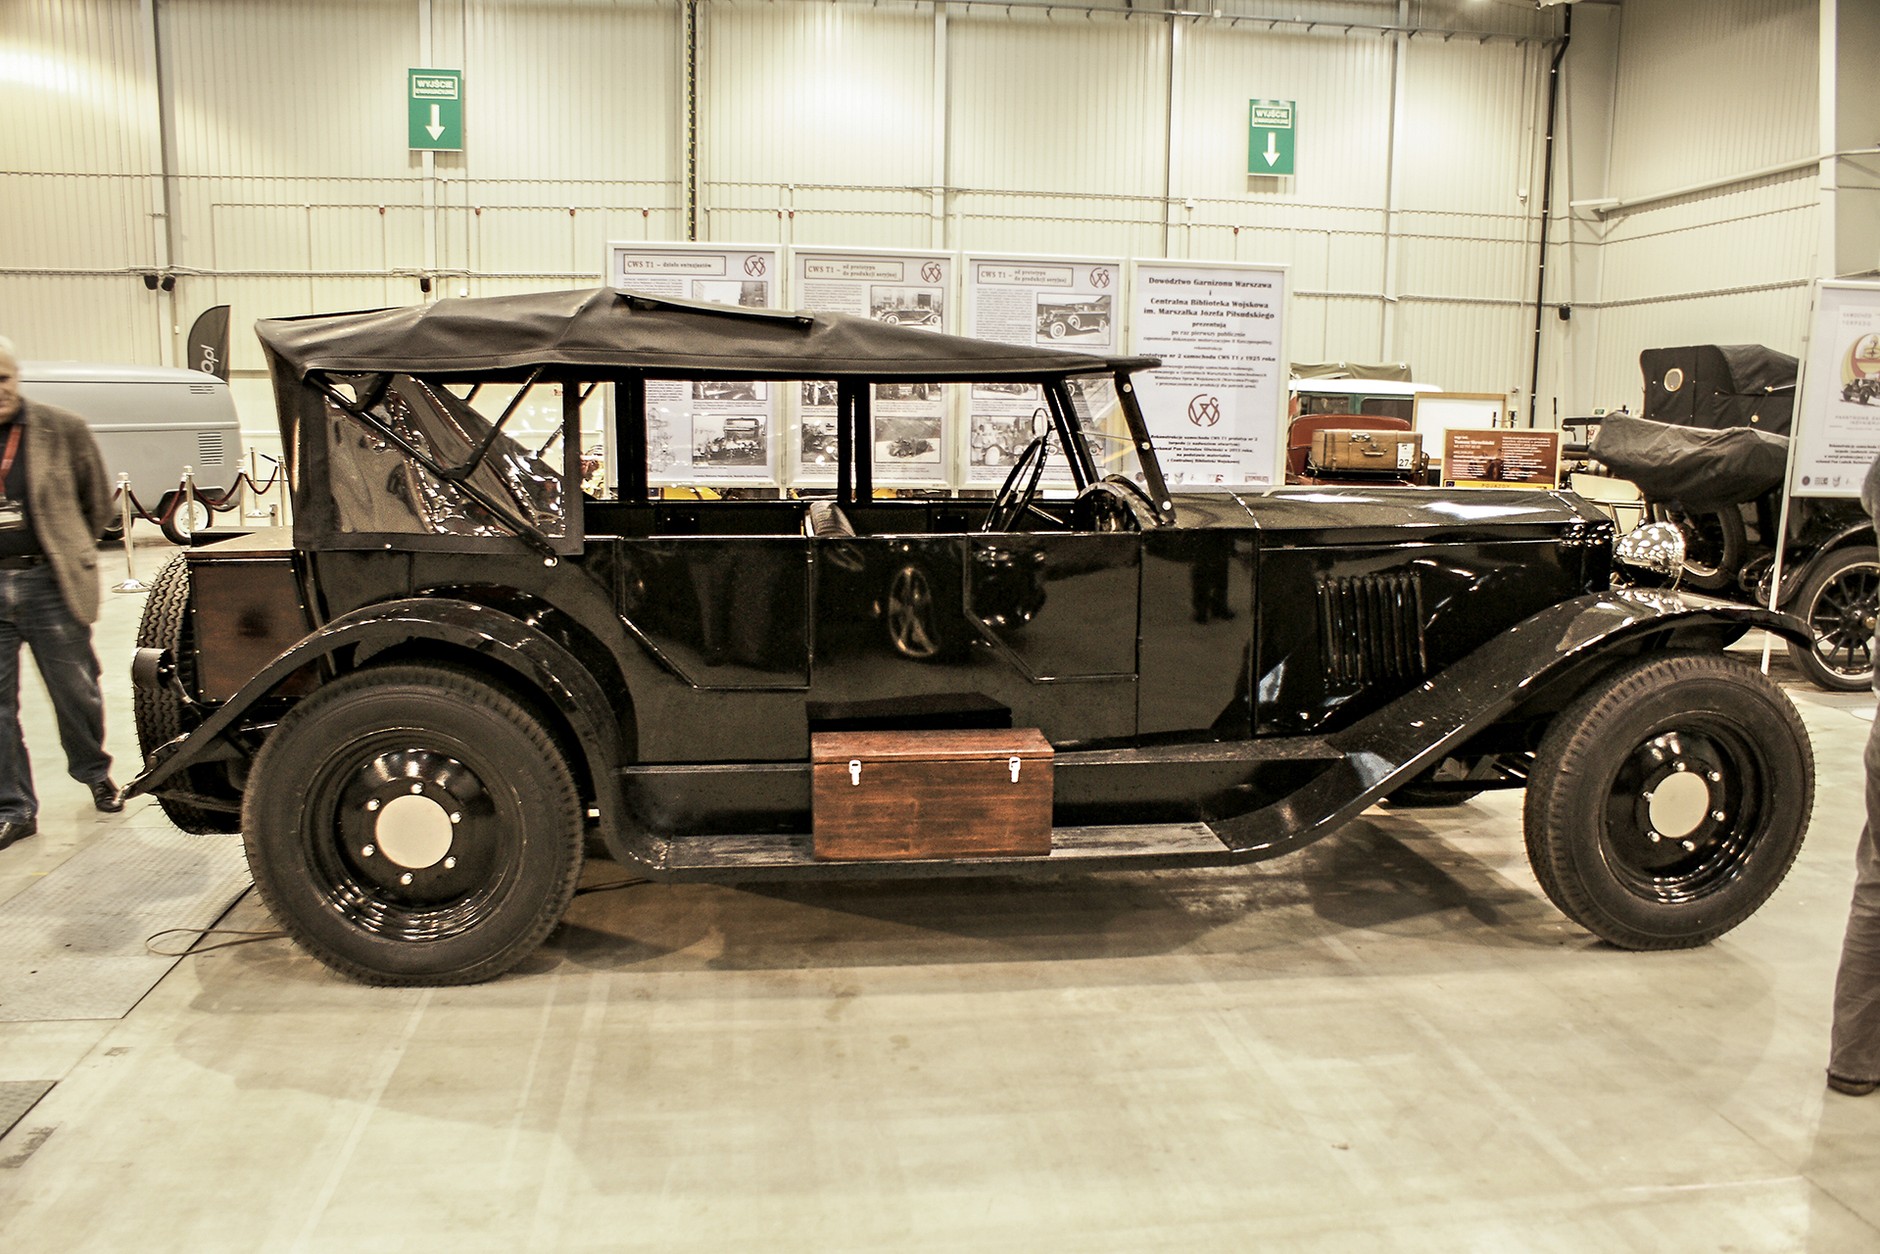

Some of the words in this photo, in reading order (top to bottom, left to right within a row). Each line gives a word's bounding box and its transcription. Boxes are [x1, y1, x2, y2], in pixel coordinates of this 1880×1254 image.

[627, 260, 644, 268] CWS
[808, 265, 824, 273] CWS
[980, 270, 996, 278] CWS
[1194, 278, 1233, 287] Garnizonu
[1235, 280, 1272, 289] Warszawa
[1150, 297, 1188, 306] Centralna
[1191, 298, 1230, 307] Biblioteka
[1232, 301, 1269, 309] Wojskowa
[1226, 311, 1275, 320] Piłsudskiego
